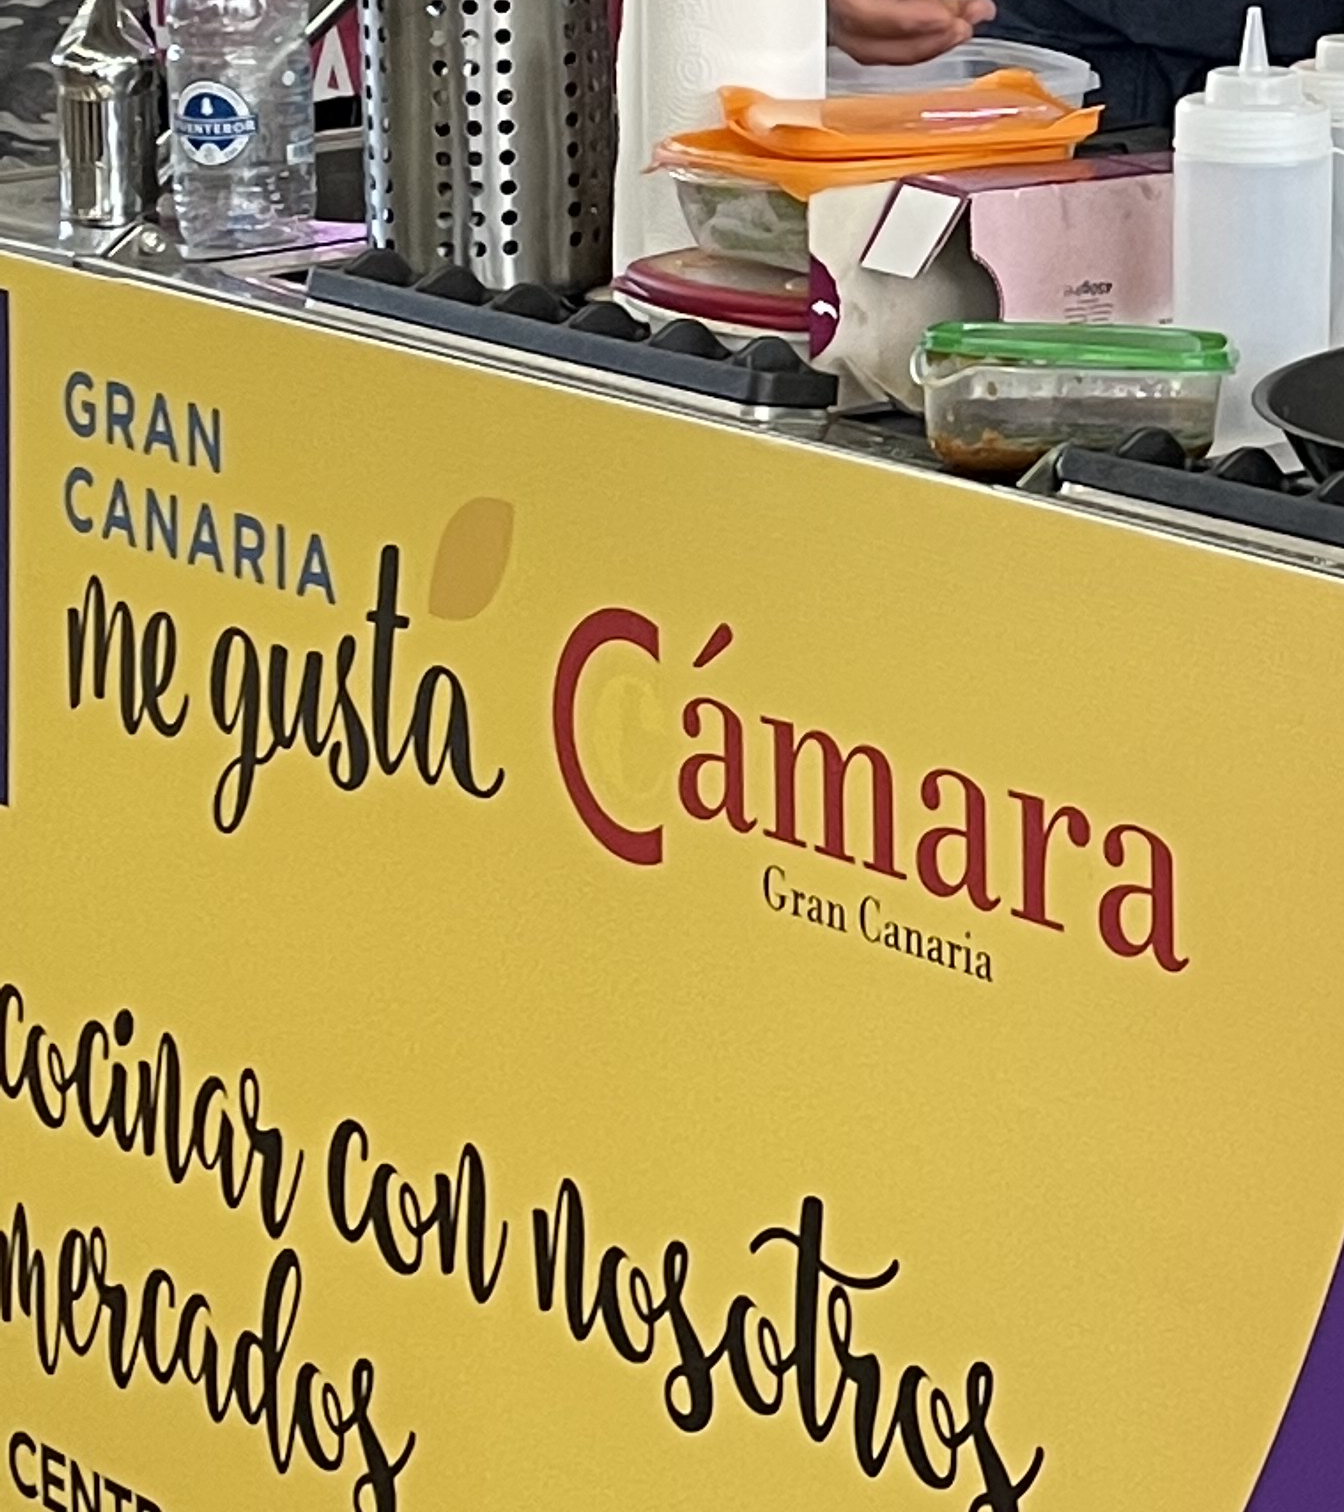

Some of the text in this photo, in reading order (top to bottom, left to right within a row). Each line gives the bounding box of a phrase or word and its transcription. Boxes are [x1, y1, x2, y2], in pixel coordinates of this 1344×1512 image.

[63, 371, 222, 474] GRAN
[63, 466, 337, 605] CANARIA
[66, 544, 506, 835] me gusta
[551, 606, 1190, 973] Cámara
[762, 864, 994, 983] Gran Canaria
[0, 984, 1045, 1512] cocinar con nosotros
[8, 1430, 166, 1512] CENT
